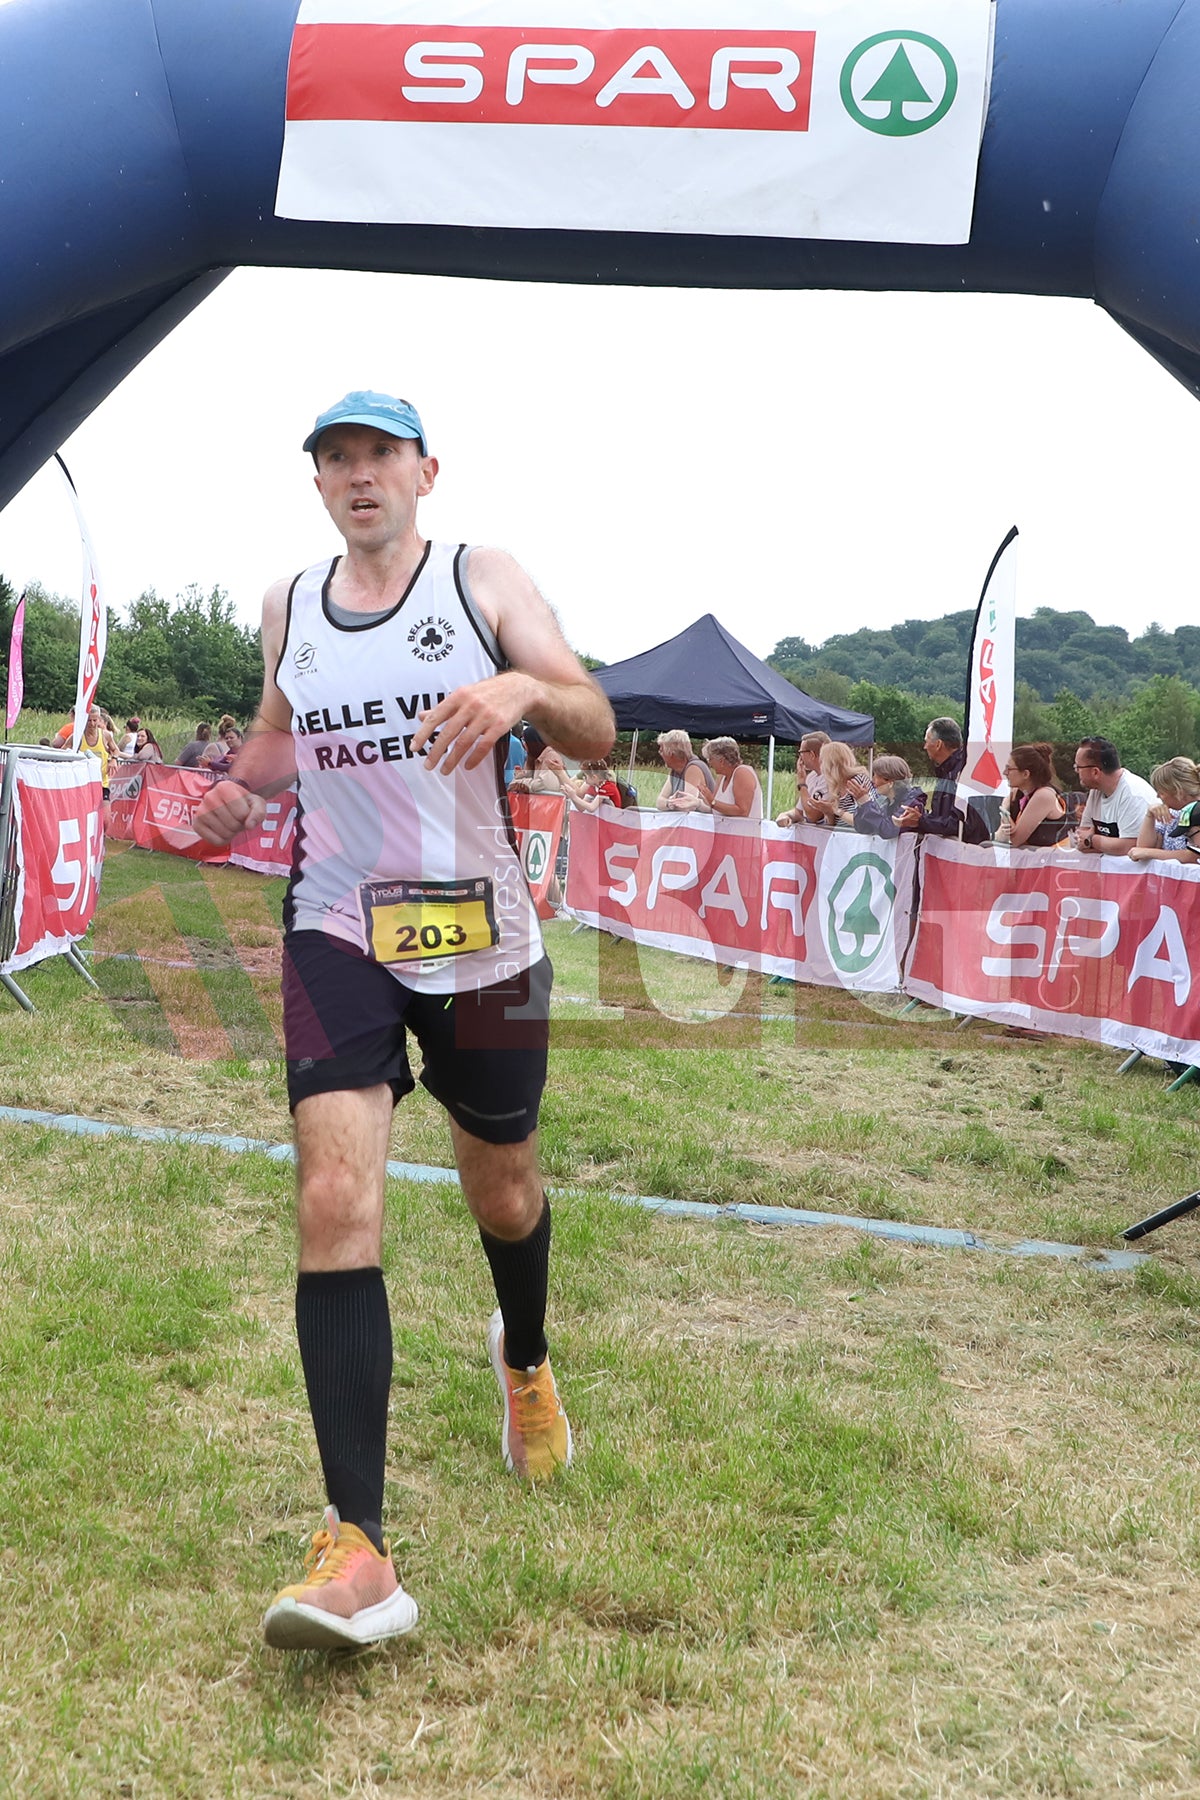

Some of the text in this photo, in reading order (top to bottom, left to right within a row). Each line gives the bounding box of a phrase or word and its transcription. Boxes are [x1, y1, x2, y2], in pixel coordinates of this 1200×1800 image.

[400, 41, 800, 113] SPAR
[407, 616, 456, 642] BELLE VUE
[411, 643, 454, 662] RACERS
[395, 691, 452, 720] VU
[604, 842, 809, 937] SPAR
[395, 924, 467, 953] 203
[981, 891, 1192, 1007] SPA
